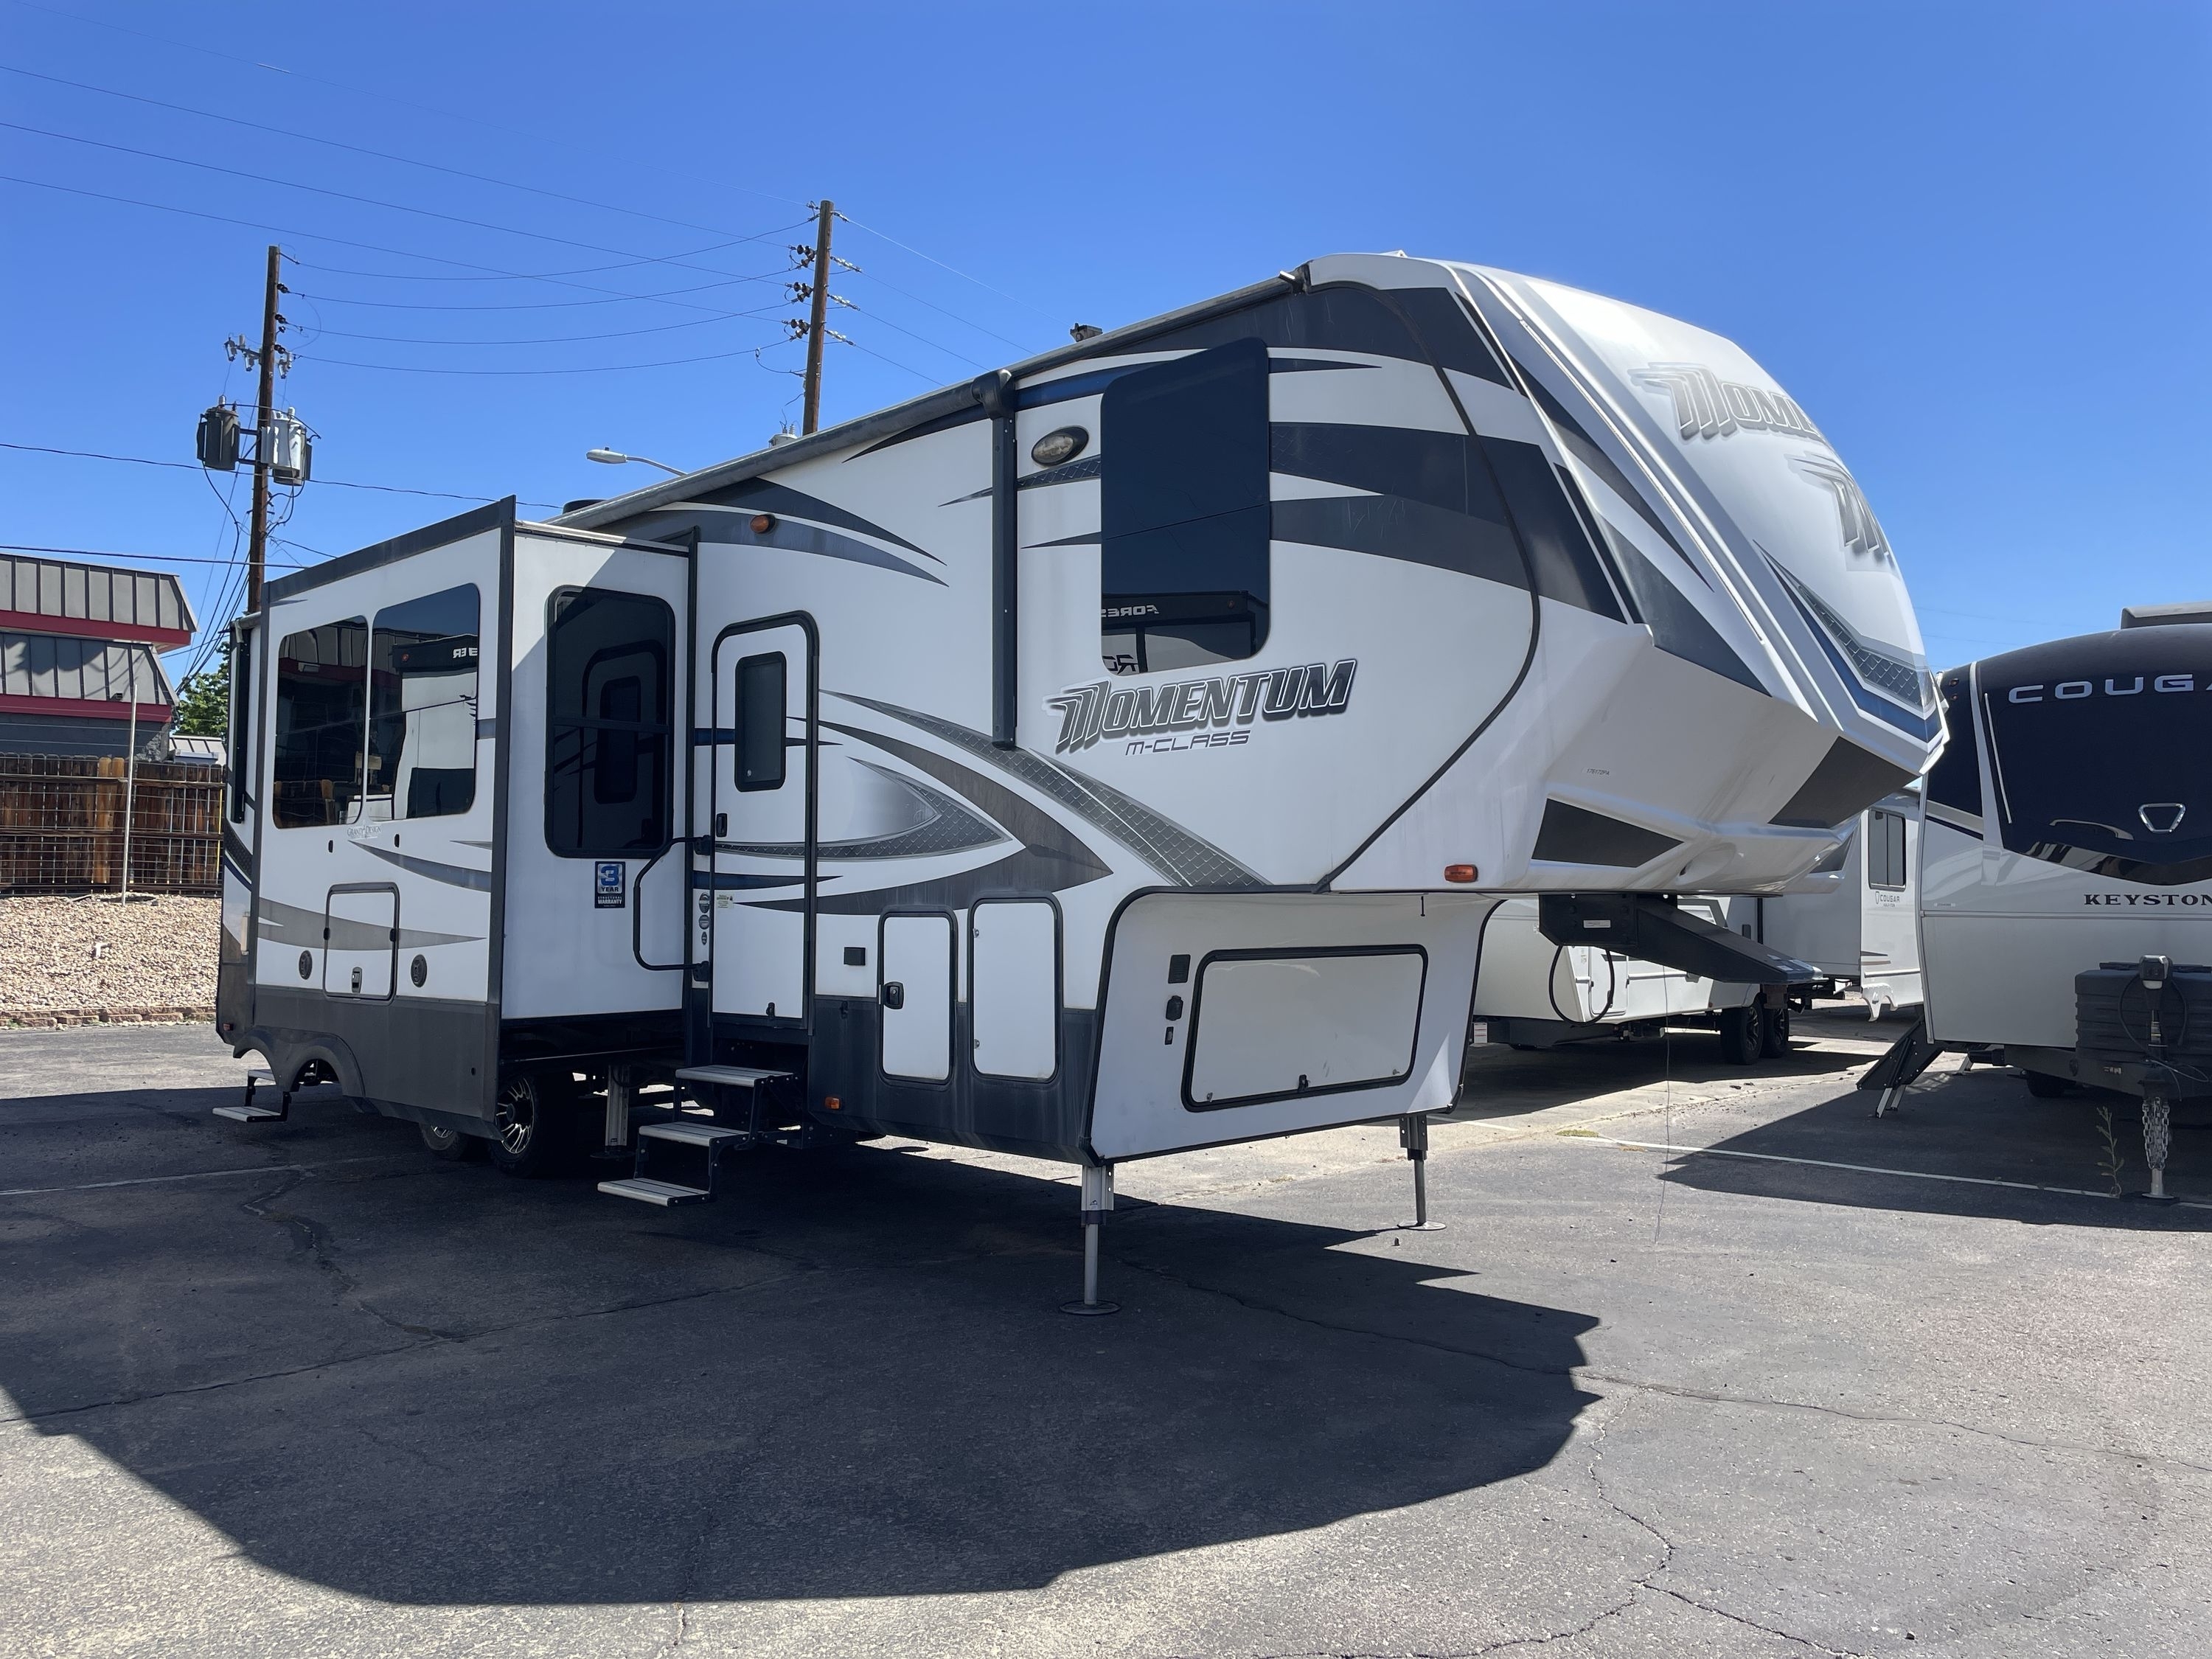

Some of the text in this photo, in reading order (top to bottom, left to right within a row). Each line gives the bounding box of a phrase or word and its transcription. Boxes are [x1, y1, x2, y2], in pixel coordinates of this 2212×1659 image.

[2008, 674, 2212, 704] COUG
[1045, 658, 1358, 755] MOMENTUM
[601, 866, 619, 886] 3
[1880, 894, 1900, 902] COUGAR
